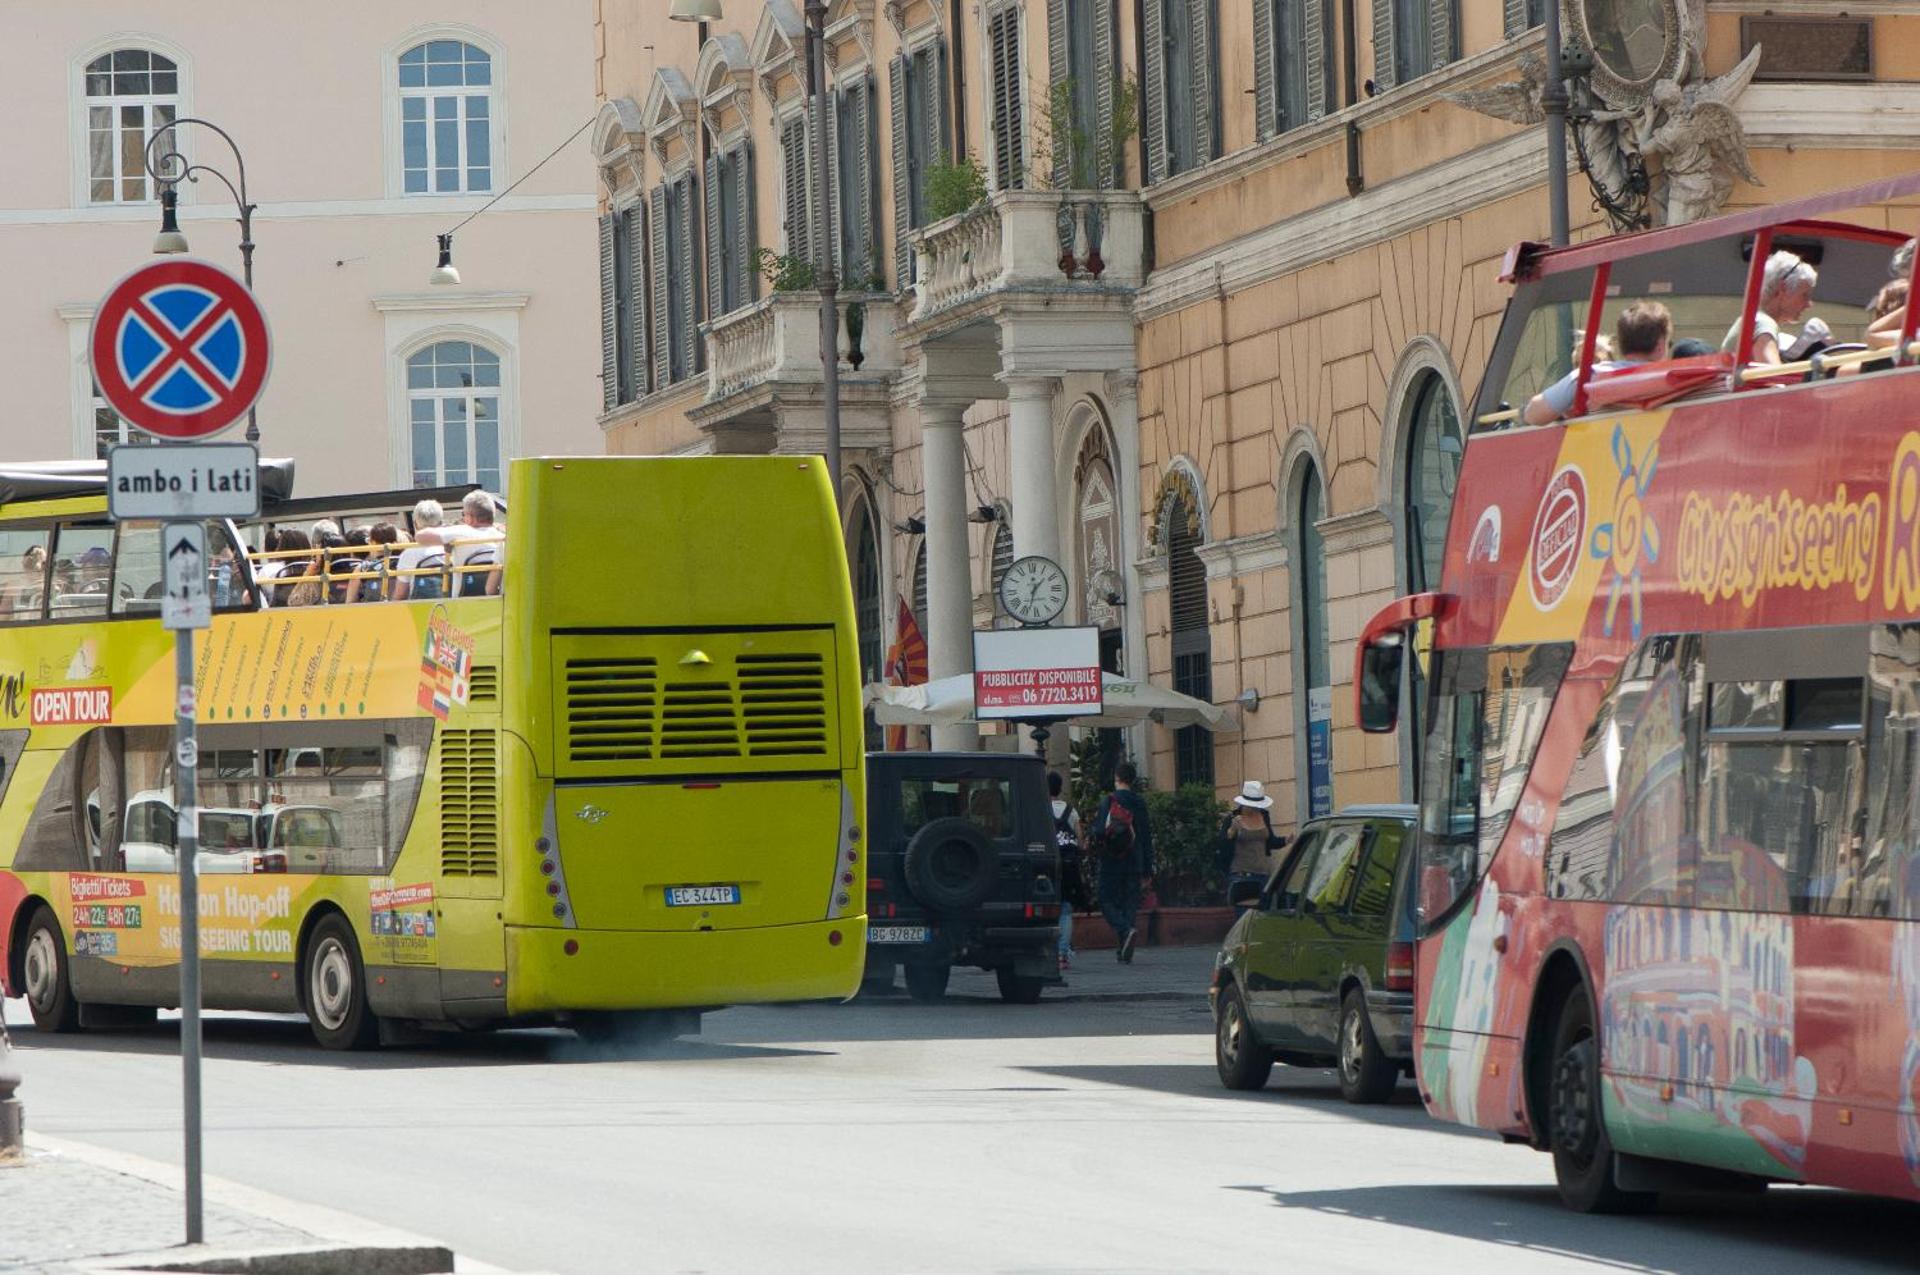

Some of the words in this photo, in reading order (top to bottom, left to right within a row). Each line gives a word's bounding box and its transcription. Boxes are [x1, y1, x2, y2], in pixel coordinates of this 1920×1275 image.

[118, 468, 181, 492] ambo
[192, 468, 198, 492] i
[208, 468, 251, 492] lati
[1040, 669, 1096, 684] DISPONIBILE
[1023, 688, 1037, 703] 06
[1040, 685, 1097, 703] 7720.3419
[34, 692, 70, 722] OPEN
[73, 690, 110, 721] TOUR
[253, 930, 292, 953] TOUR
